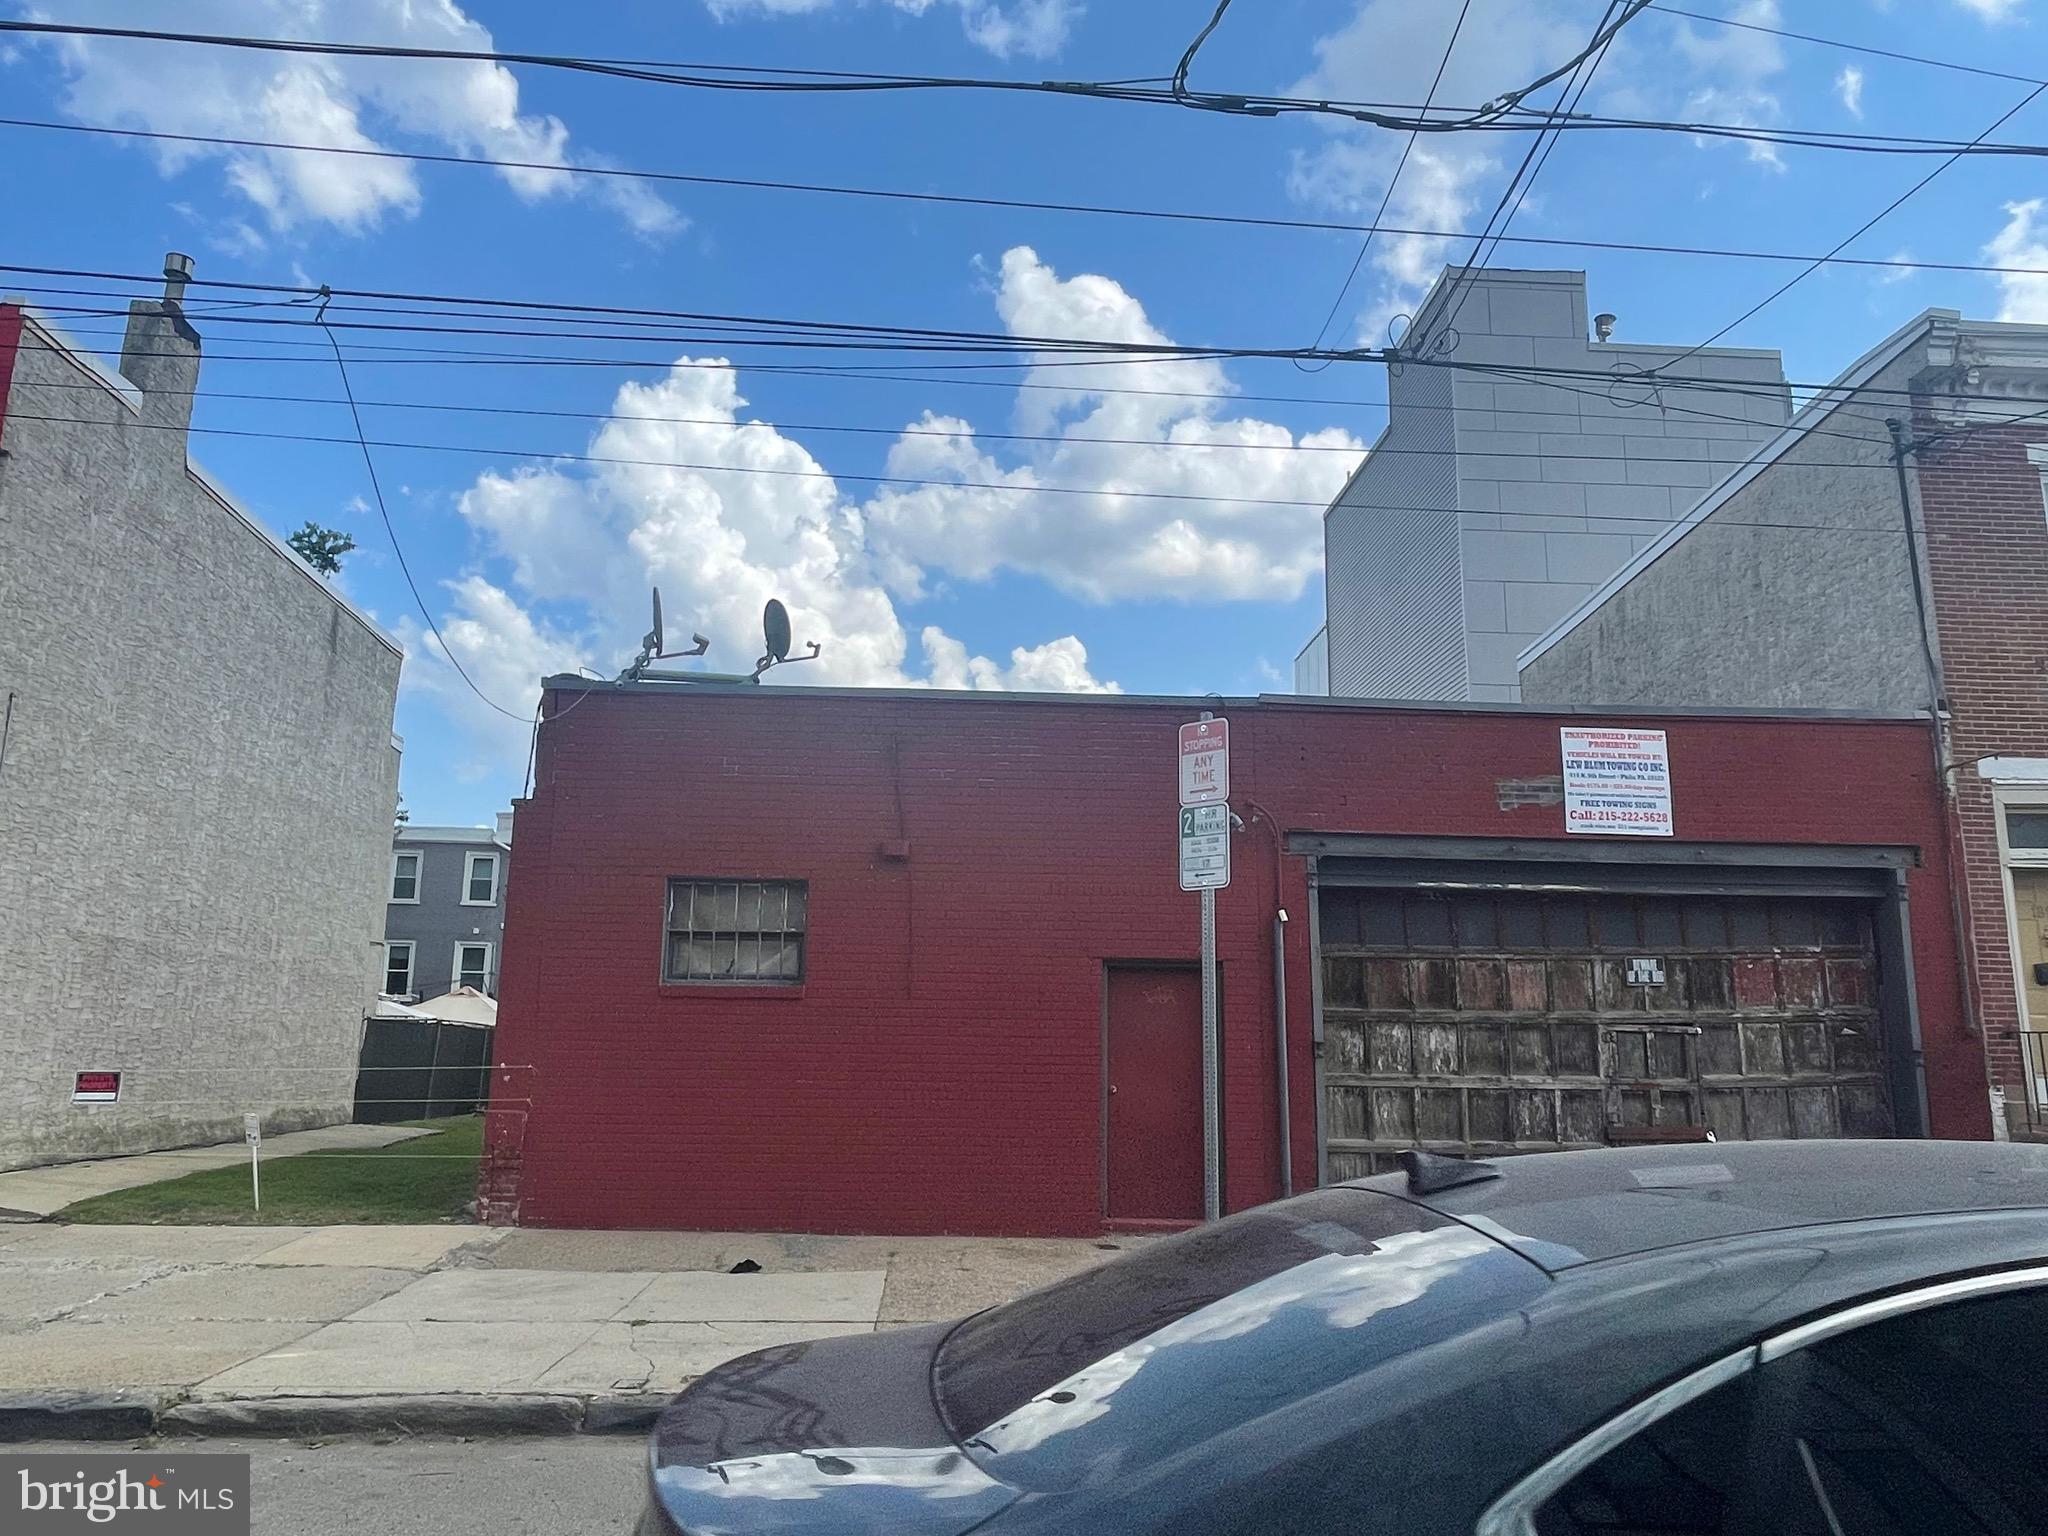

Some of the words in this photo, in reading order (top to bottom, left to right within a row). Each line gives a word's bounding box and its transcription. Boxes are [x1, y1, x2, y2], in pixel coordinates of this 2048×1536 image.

[1184, 735, 1223, 751] STOPPING
[1627, 733, 1664, 742] PARKING
[1194, 754, 1215, 769] ANY
[1566, 760, 1583, 769] LEW
[1584, 760, 1607, 770] BLUM
[1607, 761, 1637, 771] TOWING
[1638, 762, 1649, 772] CO
[1650, 763, 1666, 773] INC.
[1193, 769, 1216, 784] TIME
[1580, 799, 1601, 808] FREE
[1602, 800, 1633, 808] TOWING
[1634, 801, 1657, 809] SIGNS
[1183, 812, 1192, 833] 2
[1569, 809, 1596, 821] Call:
[1598, 811, 1669, 823] 215-222-5628
[1196, 819, 1225, 833] PARKING
